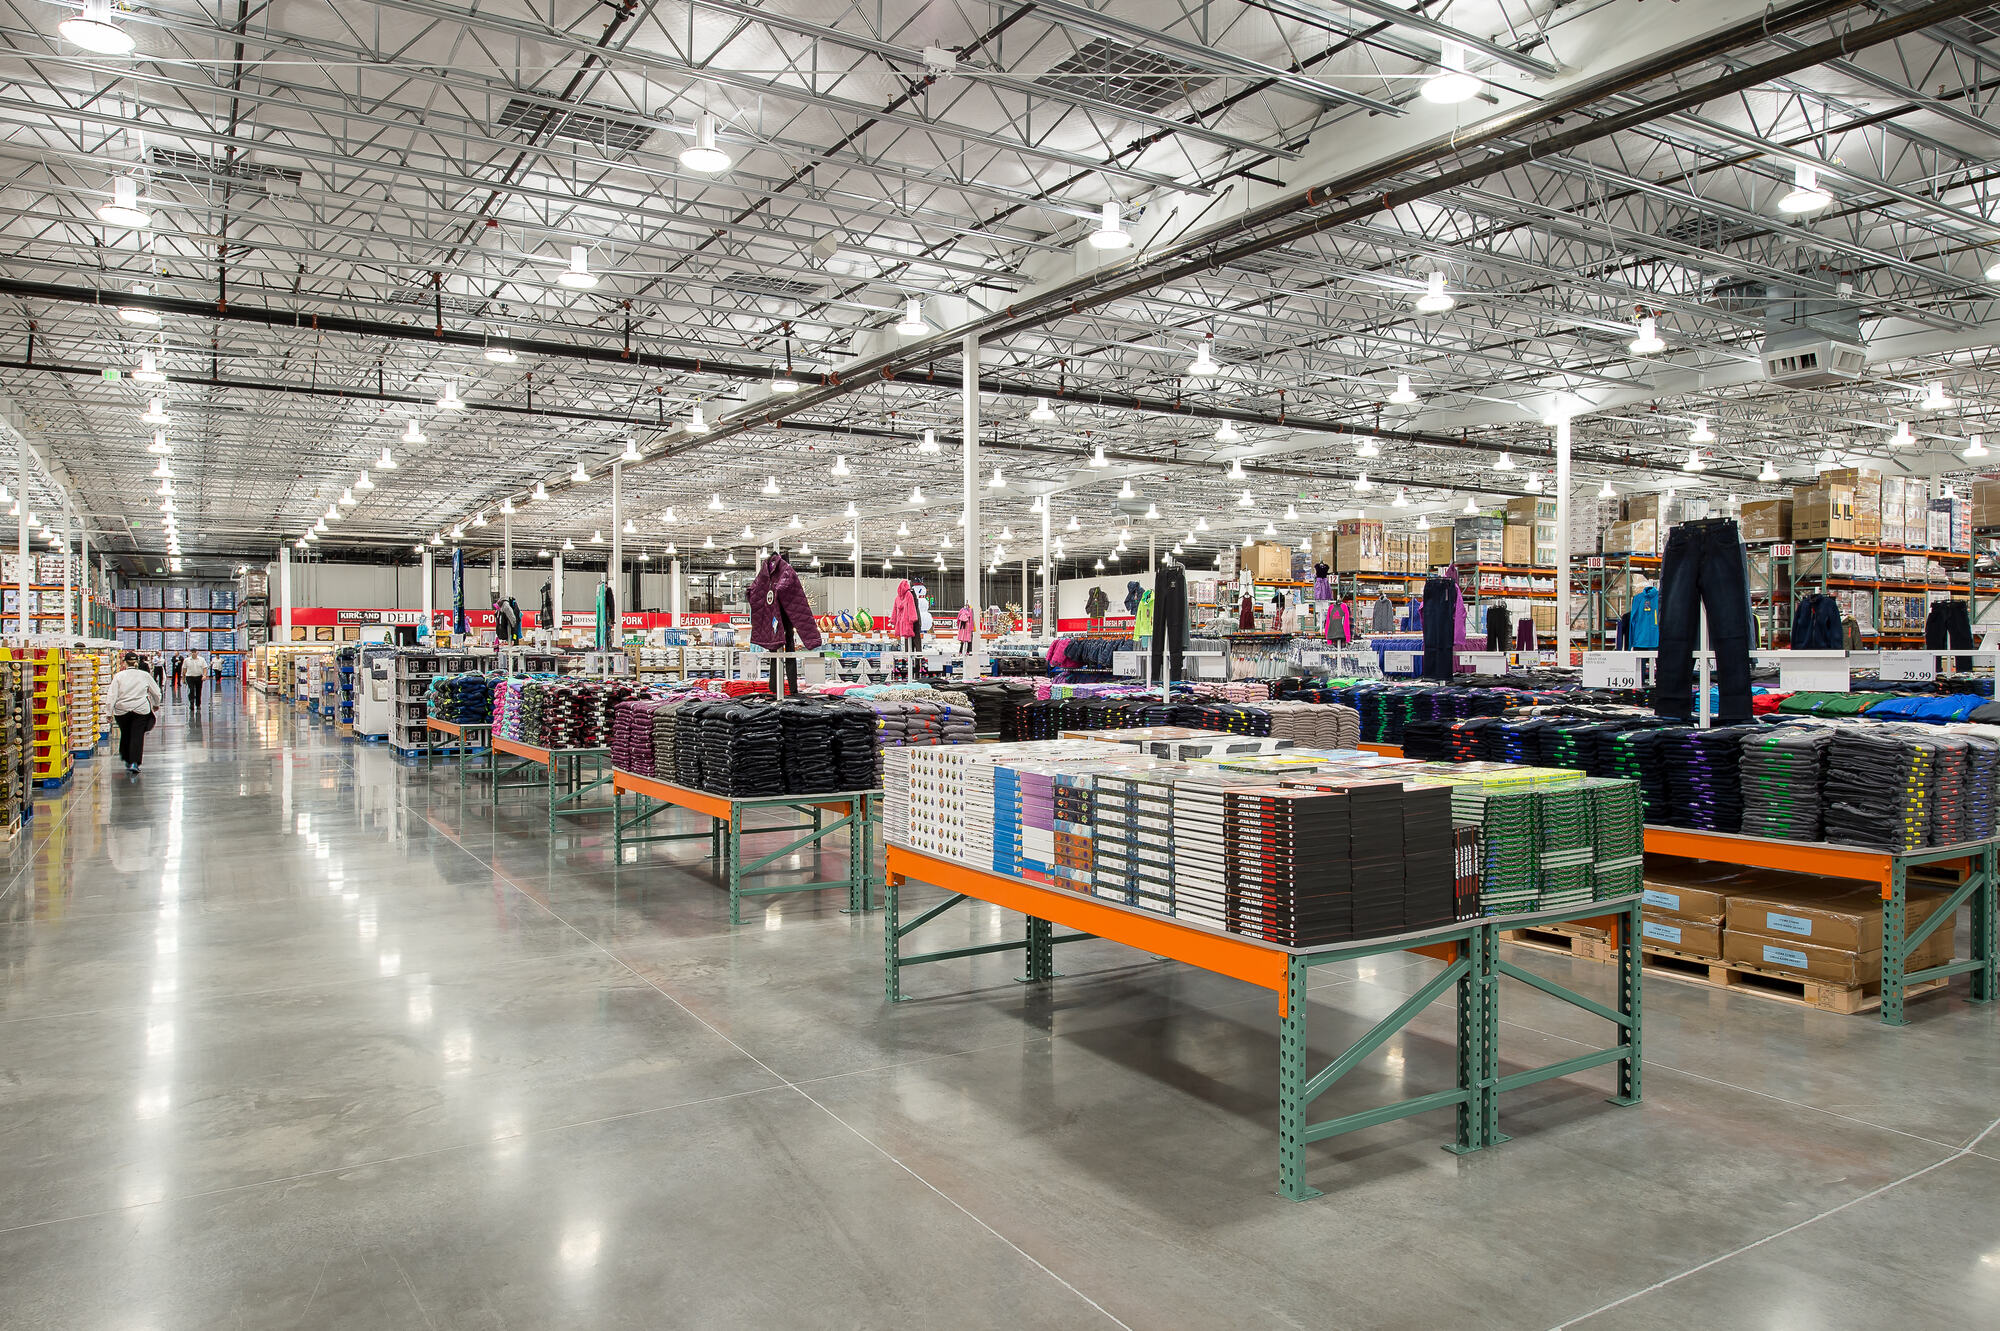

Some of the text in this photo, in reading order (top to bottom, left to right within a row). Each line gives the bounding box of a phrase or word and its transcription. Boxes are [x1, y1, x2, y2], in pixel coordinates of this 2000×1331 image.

[1776, 545, 1791, 556] 106
[1588, 557, 1602, 567] 108
[80, 587, 92, 595] 312
[1228, 582, 1239, 590] 114
[388, 613, 415, 623] DELI
[621, 616, 643, 625] PORK
[681, 616, 711, 626] EAFOOD
[732, 616, 750, 624] KIRKL
[1903, 671, 1932, 681] 29.99
[1606, 677, 1635, 688] 14.99
